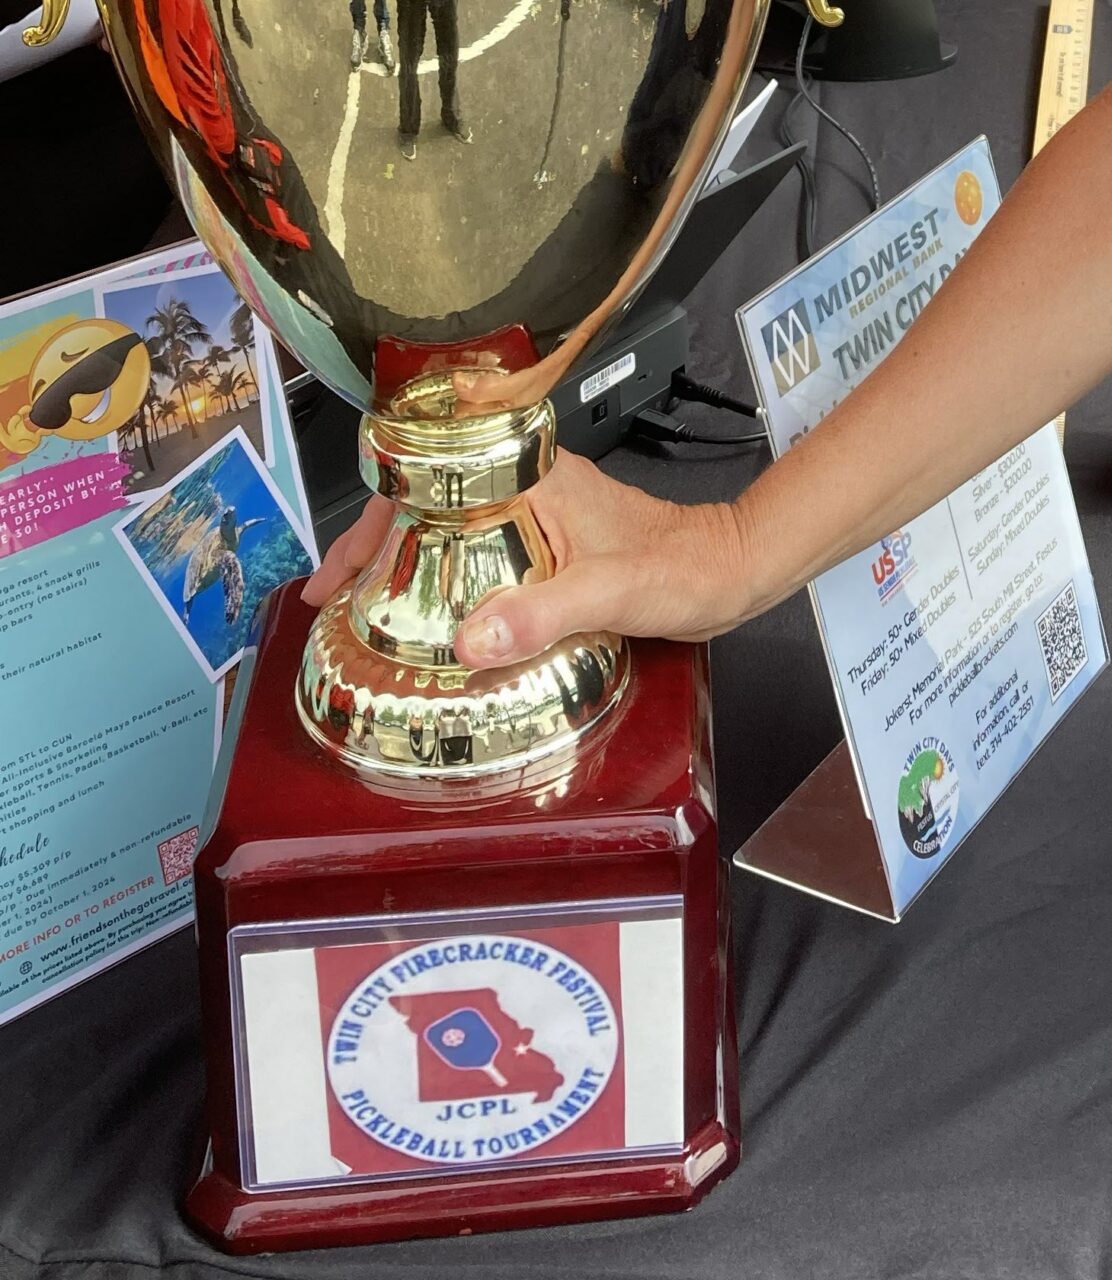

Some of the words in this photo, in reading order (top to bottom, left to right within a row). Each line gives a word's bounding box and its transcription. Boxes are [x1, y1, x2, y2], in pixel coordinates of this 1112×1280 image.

[813, 208, 939, 324] MIDWEST
[848, 266, 910, 319] REGIONAL
[912, 238, 944, 270] BANK
[832, 310, 895, 380] TWIN
[896, 272, 935, 331] CITY
[997, 443, 1026, 480] $300.00
[0, 489, 58, 519] PERSON
[63, 470, 105, 494] WHEN
[14, 495, 75, 526] DEPOSIT
[80, 486, 98, 500] BY
[974, 494, 999, 523] Bronze
[1003, 457, 1032, 495] $200.00
[14, 522, 39, 538] 30!
[967, 523, 1002, 562] Saturday:
[1002, 499, 1025, 528] Gender
[1024, 472, 1050, 504] Doubles
[976, 541, 1006, 576] Sunday:
[1005, 516, 1025, 547] Mixed
[1024, 495, 1050, 526] Doubles
[17, 569, 49, 588] resort
[44, 572, 73, 588] snack
[75, 560, 101, 577] grills
[871, 531, 912, 585] USSP
[55, 577, 88, 596] stairs)
[10, 613, 33, 627] bars
[847, 639, 889, 685] Thursday:
[888, 623, 903, 645] 50+
[903, 595, 930, 628] Gender
[930, 565, 960, 601] Doubles
[860, 663, 890, 696] Friday:
[889, 647, 904, 668] 50+
[903, 624, 928, 651] Mixed
[926, 592, 957, 632] Doubles
[884, 693, 912, 732] Jokerst
[911, 656, 946, 700] Memorial
[944, 638, 964, 664] Park
[968, 621, 983, 640] 525
[981, 596, 1004, 623] South
[1034, 537, 1059, 568] Festus
[1, 666, 26, 681] their
[28, 648, 65, 670] natural
[66, 631, 103, 652] habitat
[908, 704, 923, 726] For
[924, 683, 943, 710] more
[943, 640, 983, 689] information
[982, 632, 990, 646] or
[989, 623, 999, 636] to
[1024, 583, 1035, 601] go
[105, 720, 130, 736] Maya
[131, 704, 163, 723] Palace
[165, 689, 196, 708] Resort
[193, 705, 209, 718] etc
[975, 705, 988, 725] For
[988, 668, 1019, 710] additional
[1009, 689, 1020, 708] call
[1021, 680, 1029, 694] or
[12, 772, 45, 792] sports
[56, 742, 109, 772] Snorkeling
[18, 751, 37, 764] STL
[38, 745, 50, 755] to
[51, 733, 74, 748] CUN
[903, 741, 922, 773] TWIN
[922, 736, 940, 749] CITY
[939, 741, 955, 773] DAYS
[976, 748, 991, 771] text
[9, 805, 55, 832] shopping
[58, 793, 76, 808] and
[78, 780, 105, 797] lunch
[26, 887, 45, 902] Due
[119, 813, 192, 854] non-refundable
[53, 850, 72, 865] p/p
[913, 815, 953, 854] CELEBRATION
[4, 924, 23, 939] due
[25, 917, 37, 928] by
[40, 894, 80, 920] October
[92, 876, 116, 893] 2024
[33, 924, 61, 946] INFO
[64, 913, 81, 928] OR
[83, 904, 100, 919] TO
[102, 875, 156, 909] REGISTER
[332, 1020, 364, 1066] TWIN
[350, 976, 394, 1020] CITY
[390, 941, 550, 984] FIRECRACKER
[546, 960, 612, 1038] FESTIVAL
[341, 1089, 467, 1159] PICKLEBALL
[473, 1066, 605, 1157] TOURNAMENT
[436, 1098, 517, 1123] JCPL
